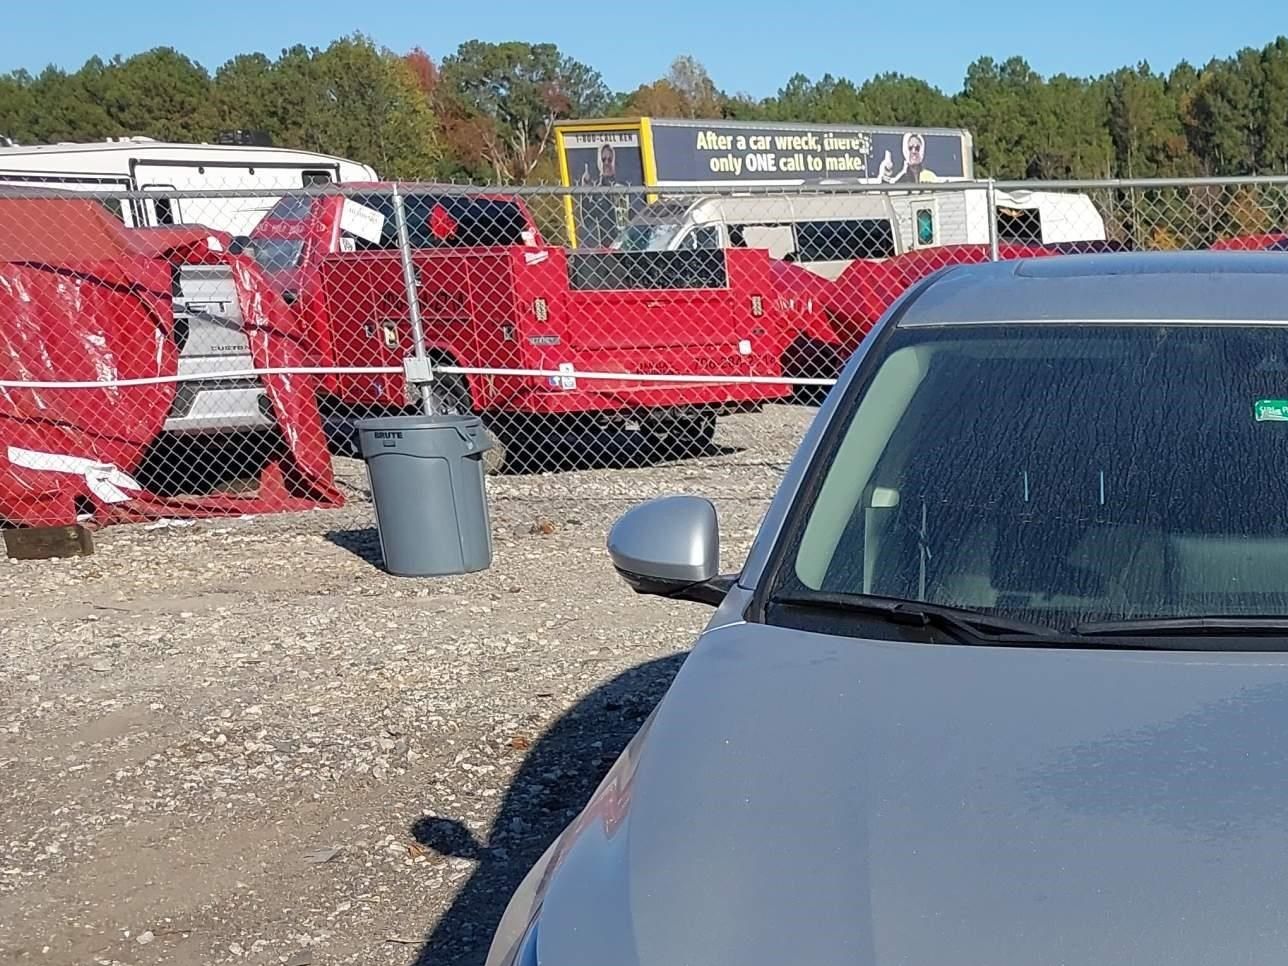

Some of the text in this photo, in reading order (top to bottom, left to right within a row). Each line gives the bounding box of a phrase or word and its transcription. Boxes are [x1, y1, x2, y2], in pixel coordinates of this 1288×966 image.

[697, 131, 733, 150] After
[736, 134, 747, 150] a
[749, 134, 772, 150] car
[774, 133, 822, 153] wreck,
[709, 153, 866, 175] only ONE call to make.
[374, 431, 403, 439] BRUTE
